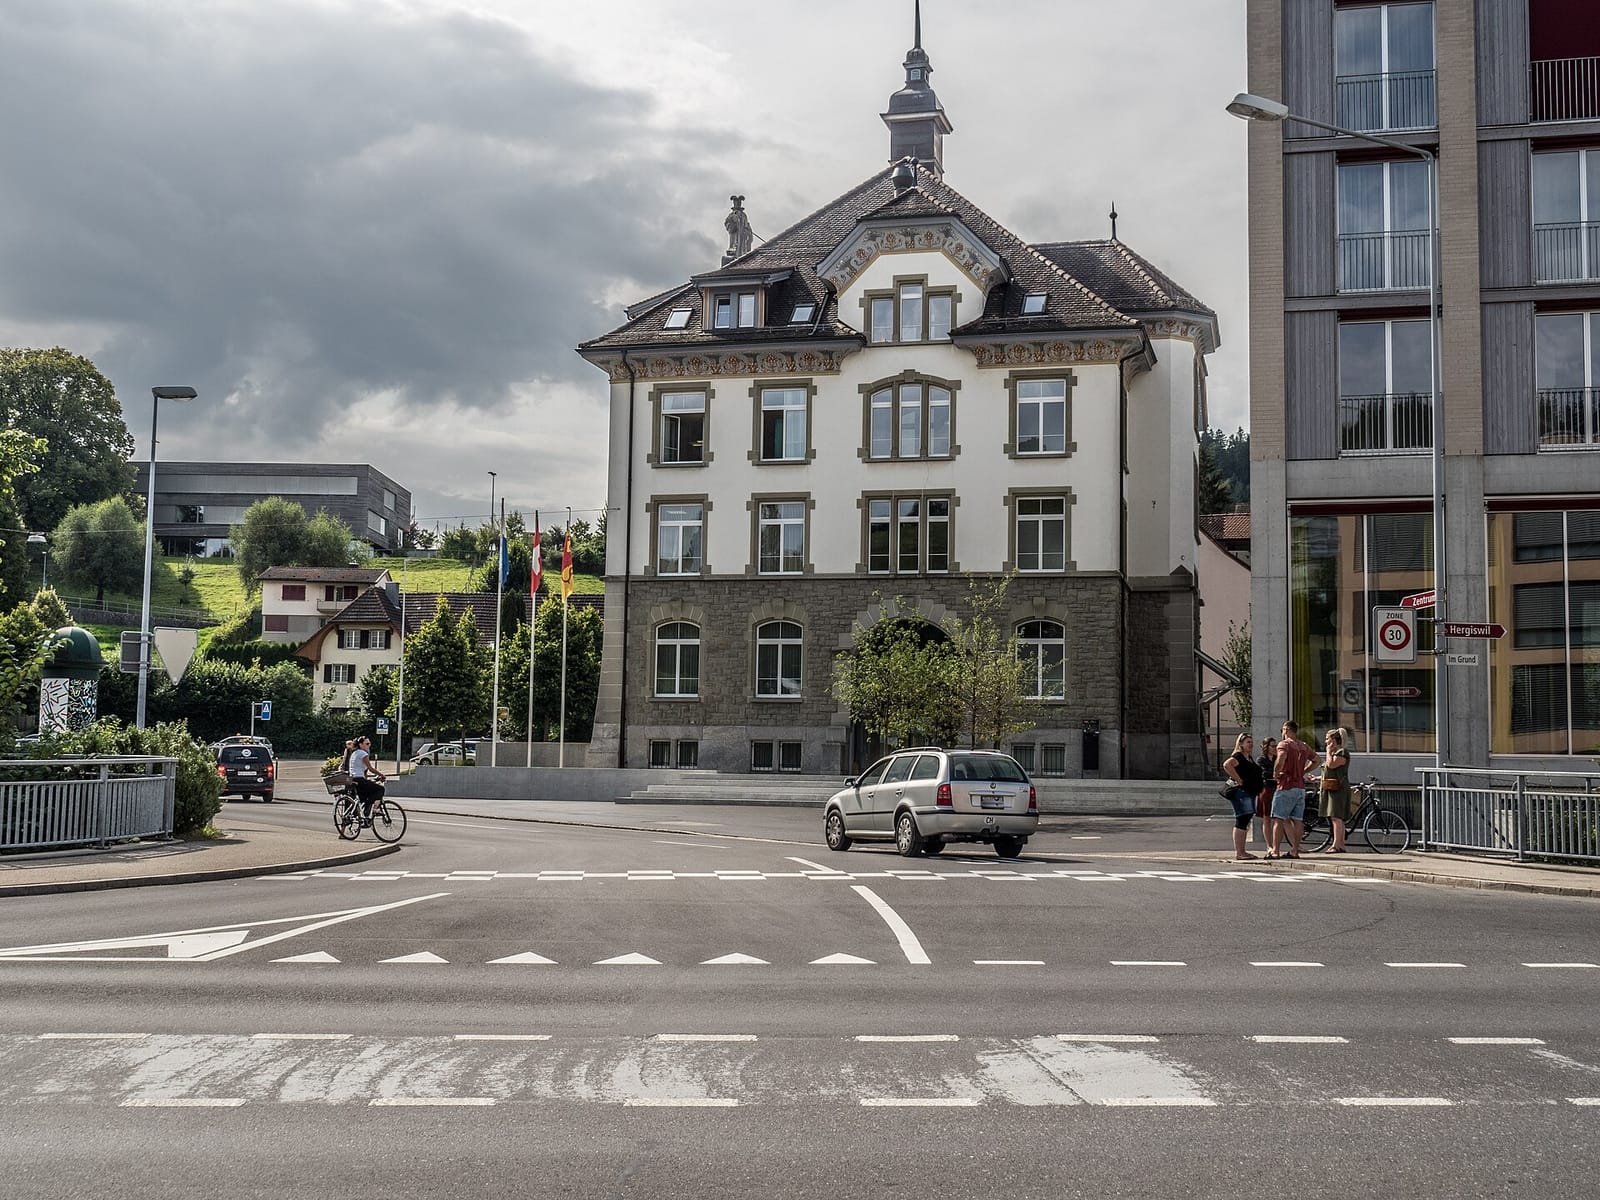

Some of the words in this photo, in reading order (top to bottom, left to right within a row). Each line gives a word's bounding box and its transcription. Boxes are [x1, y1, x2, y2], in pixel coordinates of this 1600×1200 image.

[1388, 630, 1402, 640] 30
[1450, 625, 1491, 636] Hergiswil
[378, 719, 385, 728] P
